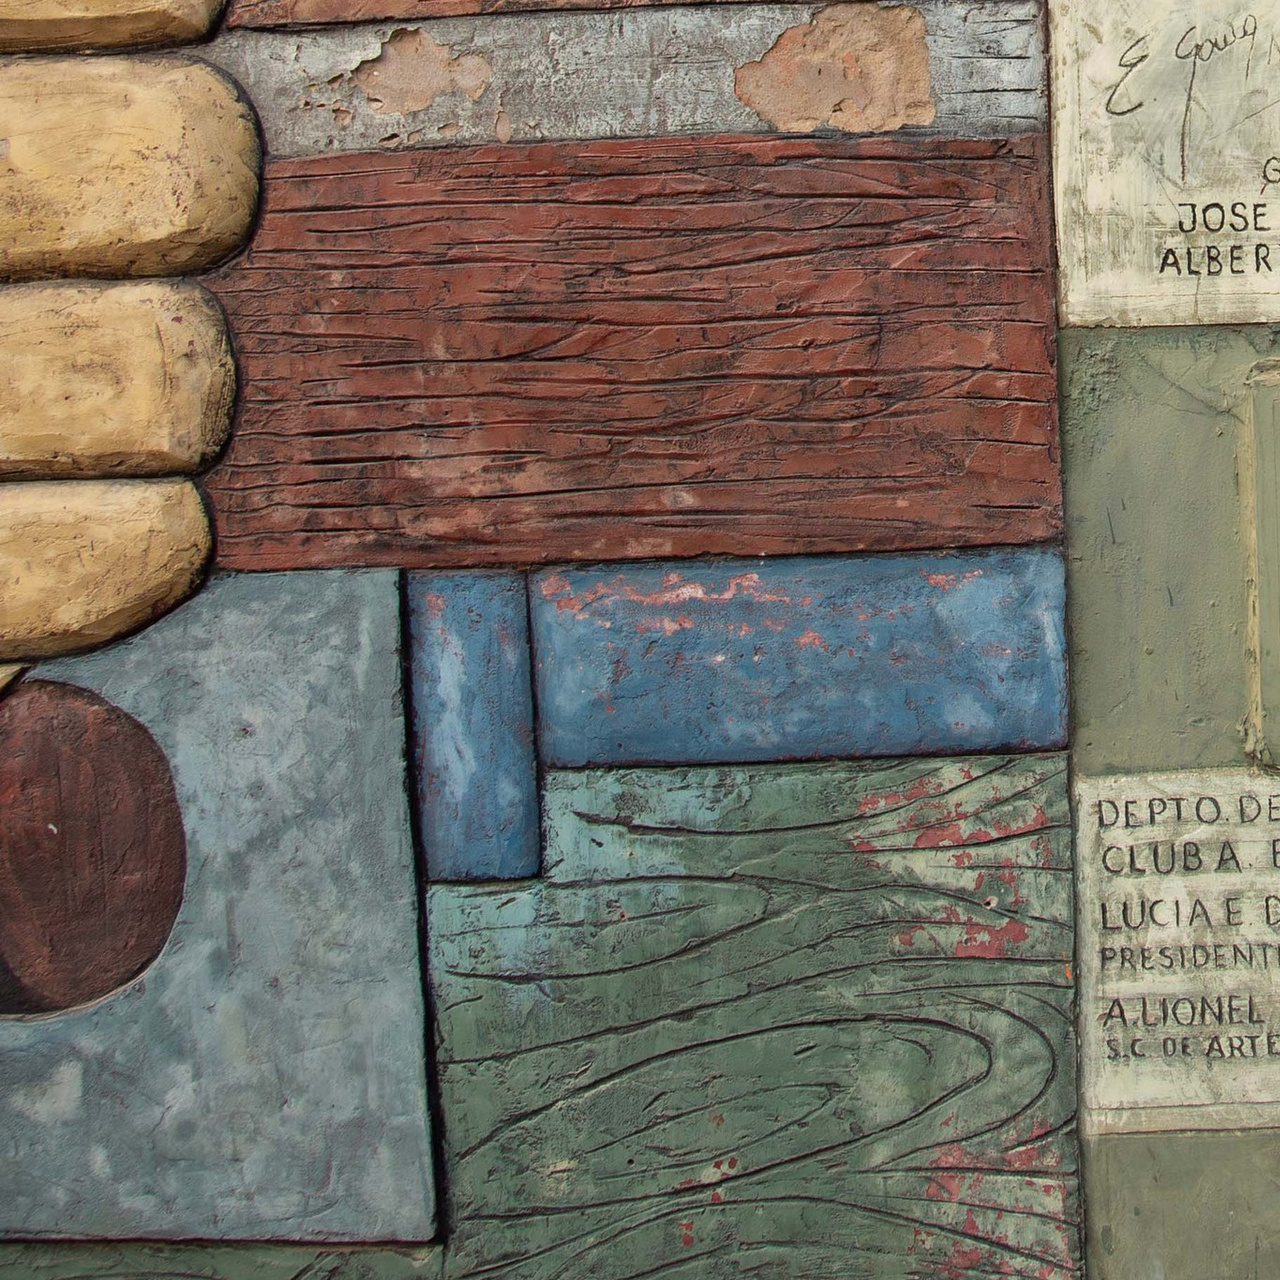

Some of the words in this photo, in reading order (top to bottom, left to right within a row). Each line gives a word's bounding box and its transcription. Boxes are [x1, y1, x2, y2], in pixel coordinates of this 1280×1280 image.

[1177, 201, 1272, 234] JOSE
[1101, 841, 1204, 875] CLUB
[1100, 897, 1214, 931] LUCIA
[1161, 1035, 1192, 1058] DE
